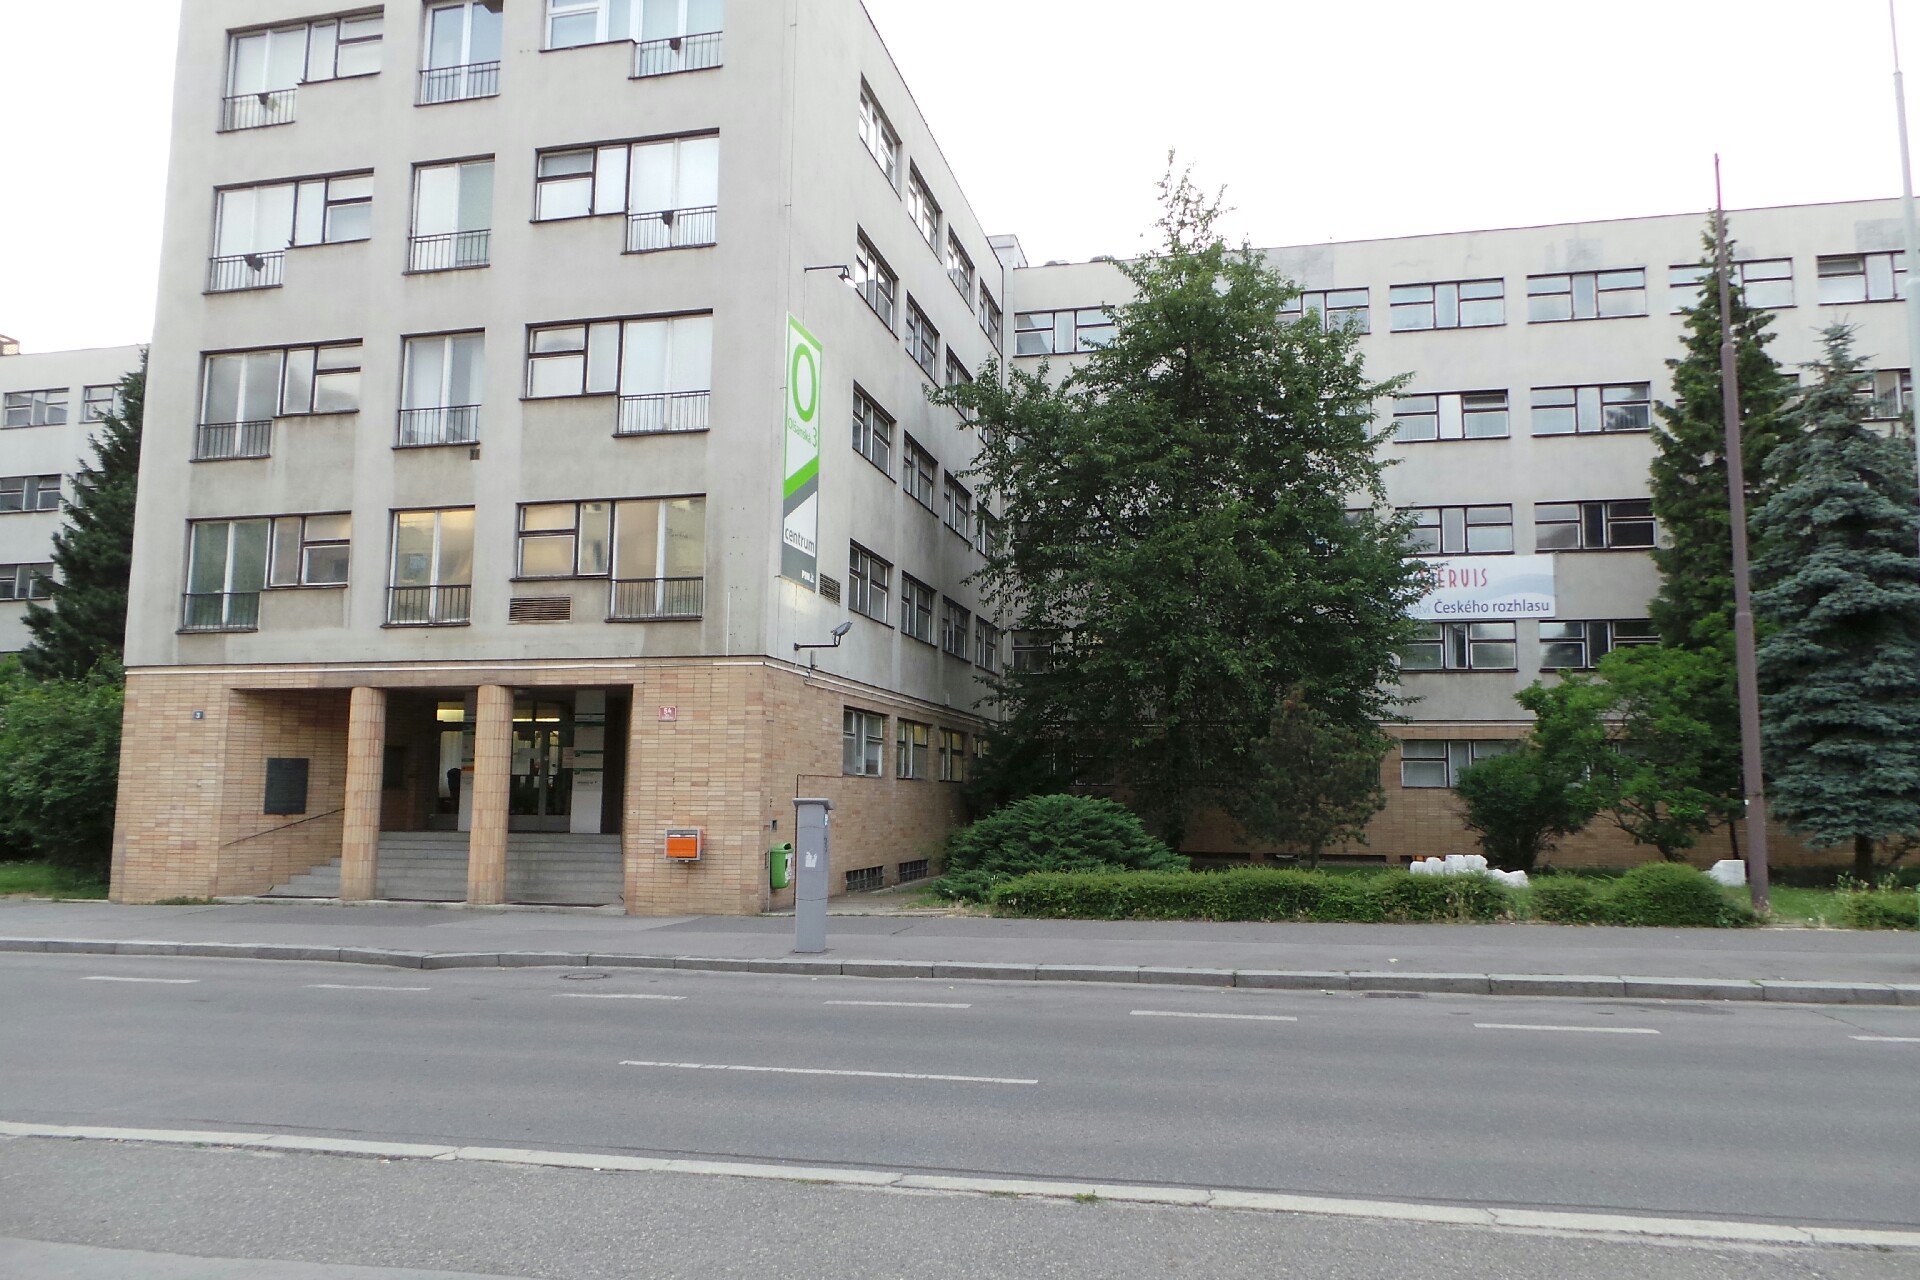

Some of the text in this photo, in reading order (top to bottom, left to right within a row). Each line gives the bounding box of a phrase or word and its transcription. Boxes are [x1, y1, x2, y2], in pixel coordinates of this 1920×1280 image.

[812, 426, 818, 448] 3
[785, 528, 815, 554] centrum
[1434, 599, 1489, 614] Českého
[1492, 599, 1549, 612] rozhlasu
